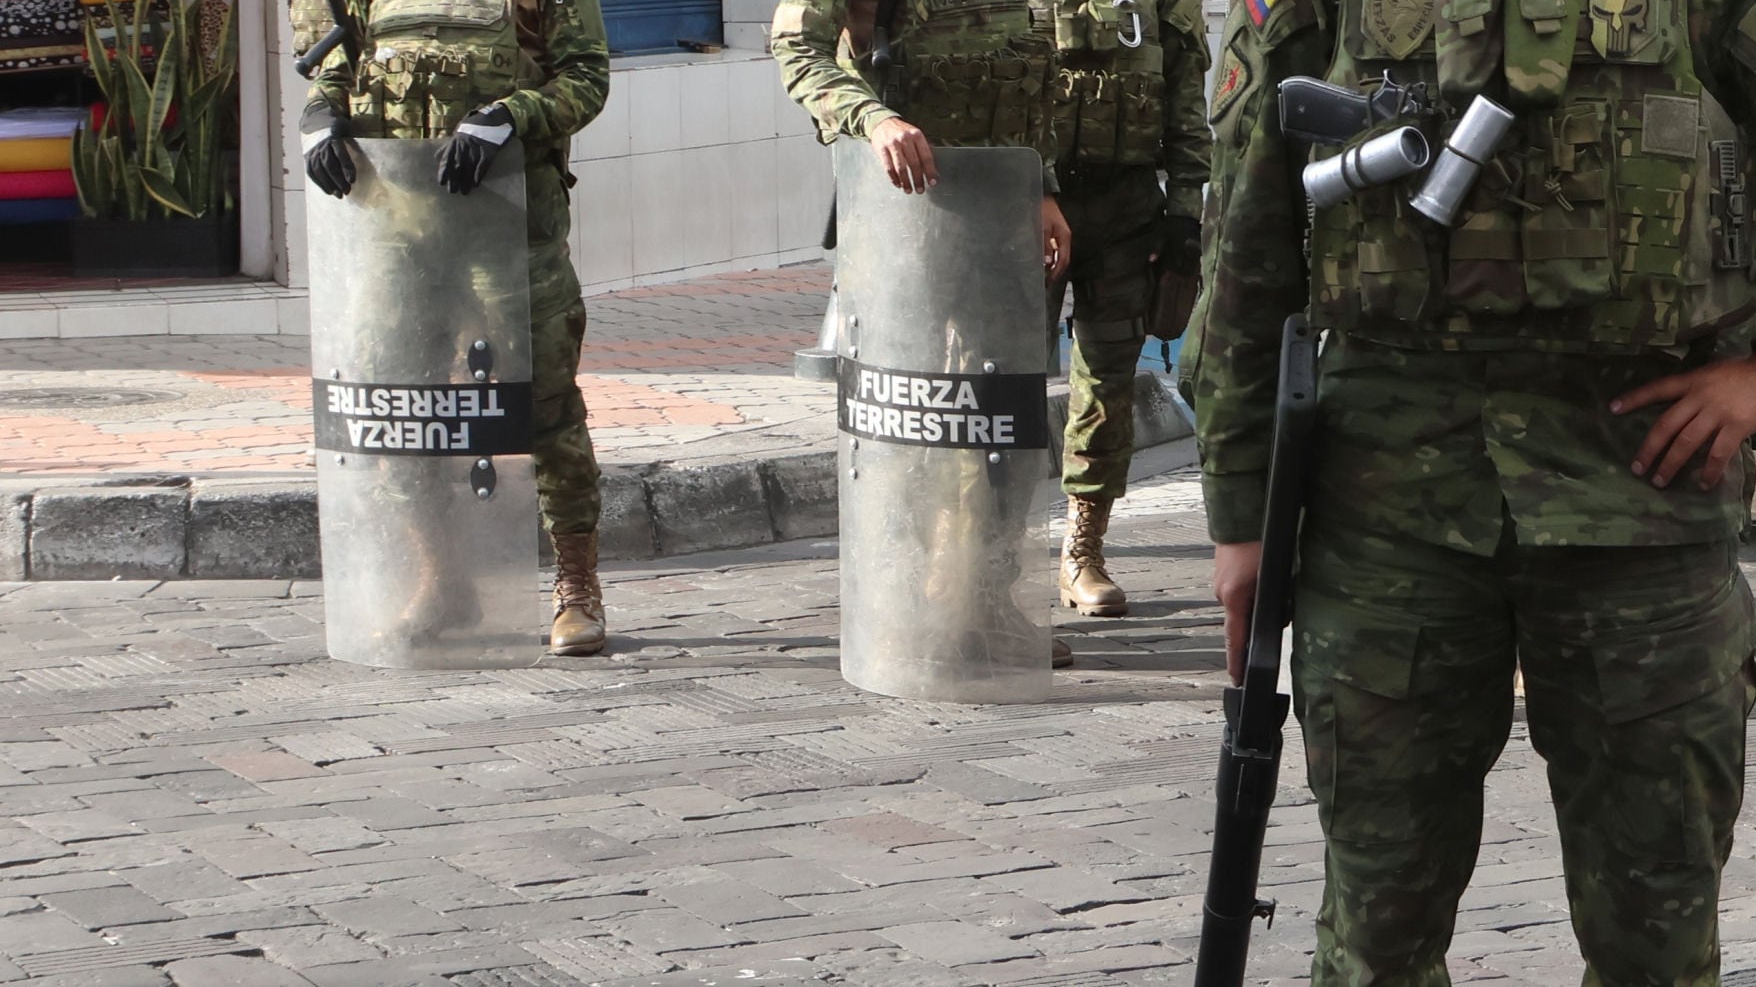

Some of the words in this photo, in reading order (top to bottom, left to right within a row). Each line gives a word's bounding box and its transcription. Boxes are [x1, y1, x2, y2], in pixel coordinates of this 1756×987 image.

[327, 385, 505, 418] TERRESTRE
[860, 369, 979, 410] FUERZA
[346, 419, 470, 449] FUERZA
[846, 398, 1015, 444] TERRESTRE
